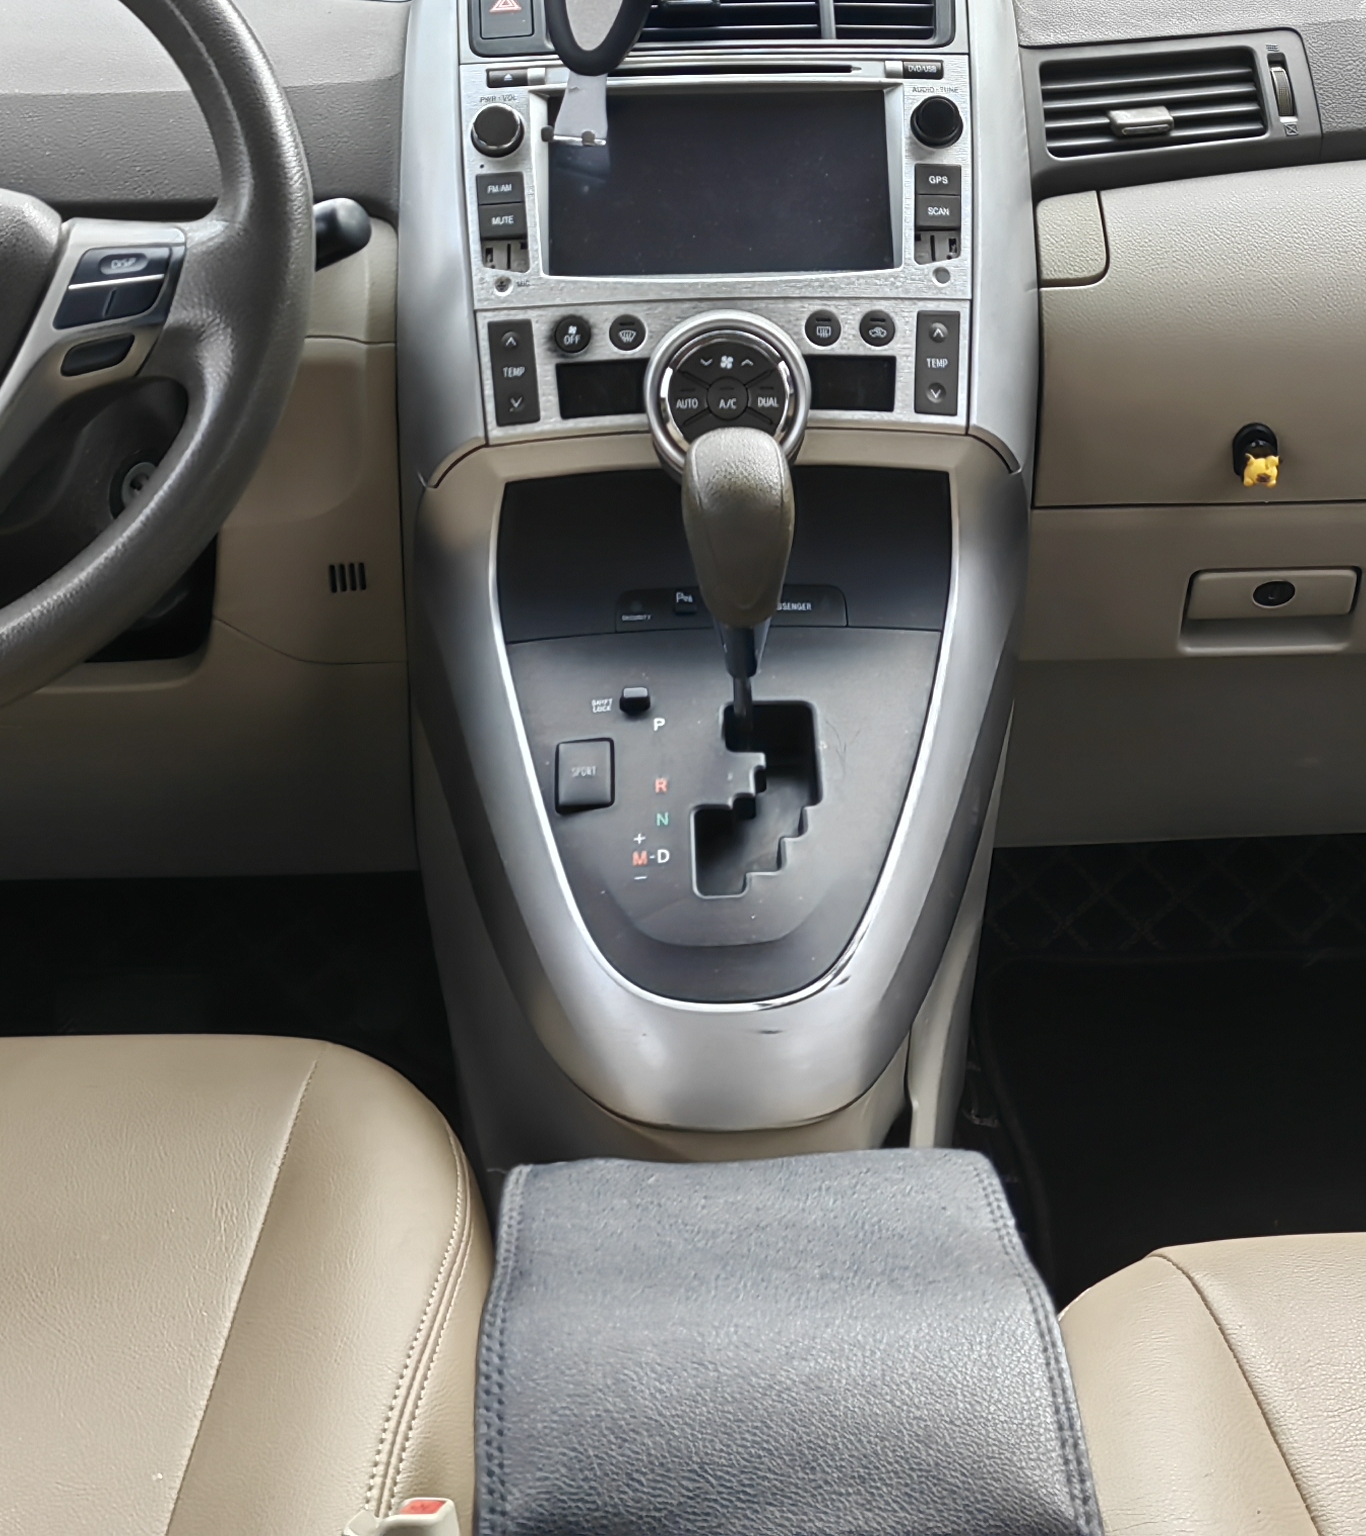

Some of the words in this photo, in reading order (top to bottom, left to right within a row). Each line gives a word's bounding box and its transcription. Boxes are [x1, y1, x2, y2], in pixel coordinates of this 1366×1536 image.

[479, 95, 496, 103] PWR
[928, 176, 949, 184] GPS
[927, 207, 950, 216] SCAN
[491, 215, 514, 225] MUTE
[563, 333, 581, 346] OFF
[926, 357, 949, 370] TEMP
[502, 365, 526, 378] TEMP
[675, 396, 699, 410] AUTO
[718, 397, 737, 411] A/C
[757, 395, 779, 409] DUAL
[592, 698, 613, 706] SHIFT
[592, 705, 611, 713] LOCK
[653, 718, 666, 731] P
[571, 765, 596, 776] SPORT
[655, 778, 668, 793] R
[657, 813, 669, 826] N
